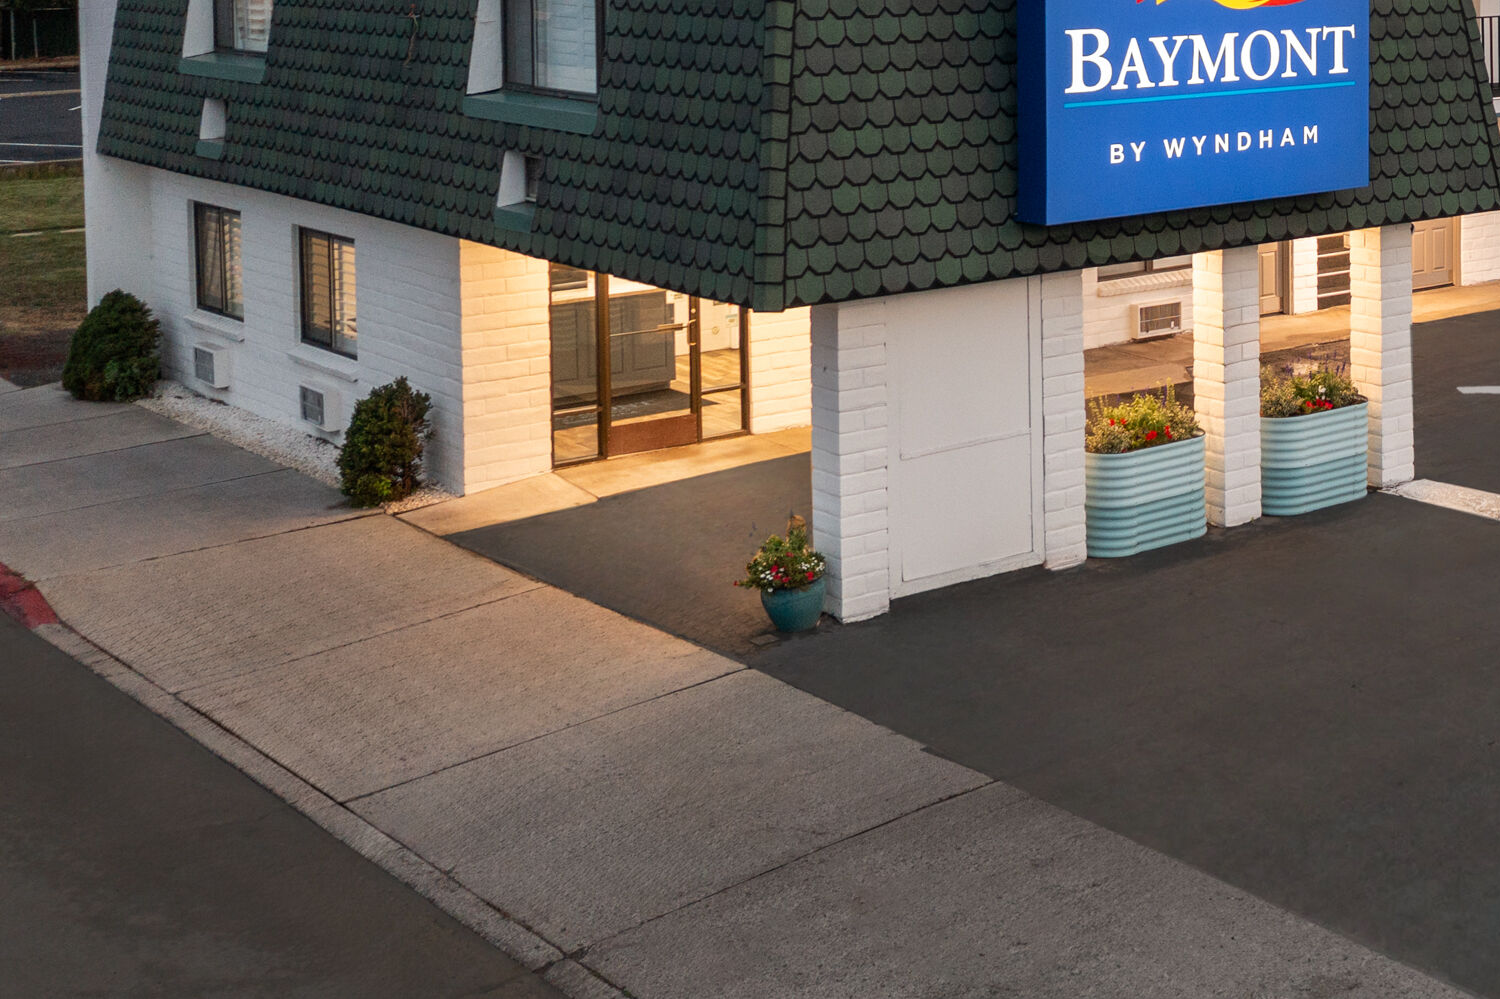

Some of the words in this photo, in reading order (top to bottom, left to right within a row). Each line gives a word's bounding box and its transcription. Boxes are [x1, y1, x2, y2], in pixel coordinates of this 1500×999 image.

[1064, 24, 1356, 94] BAYMONT
[1110, 141, 1146, 165] BY
[1163, 125, 1318, 159] WYNDHAM
